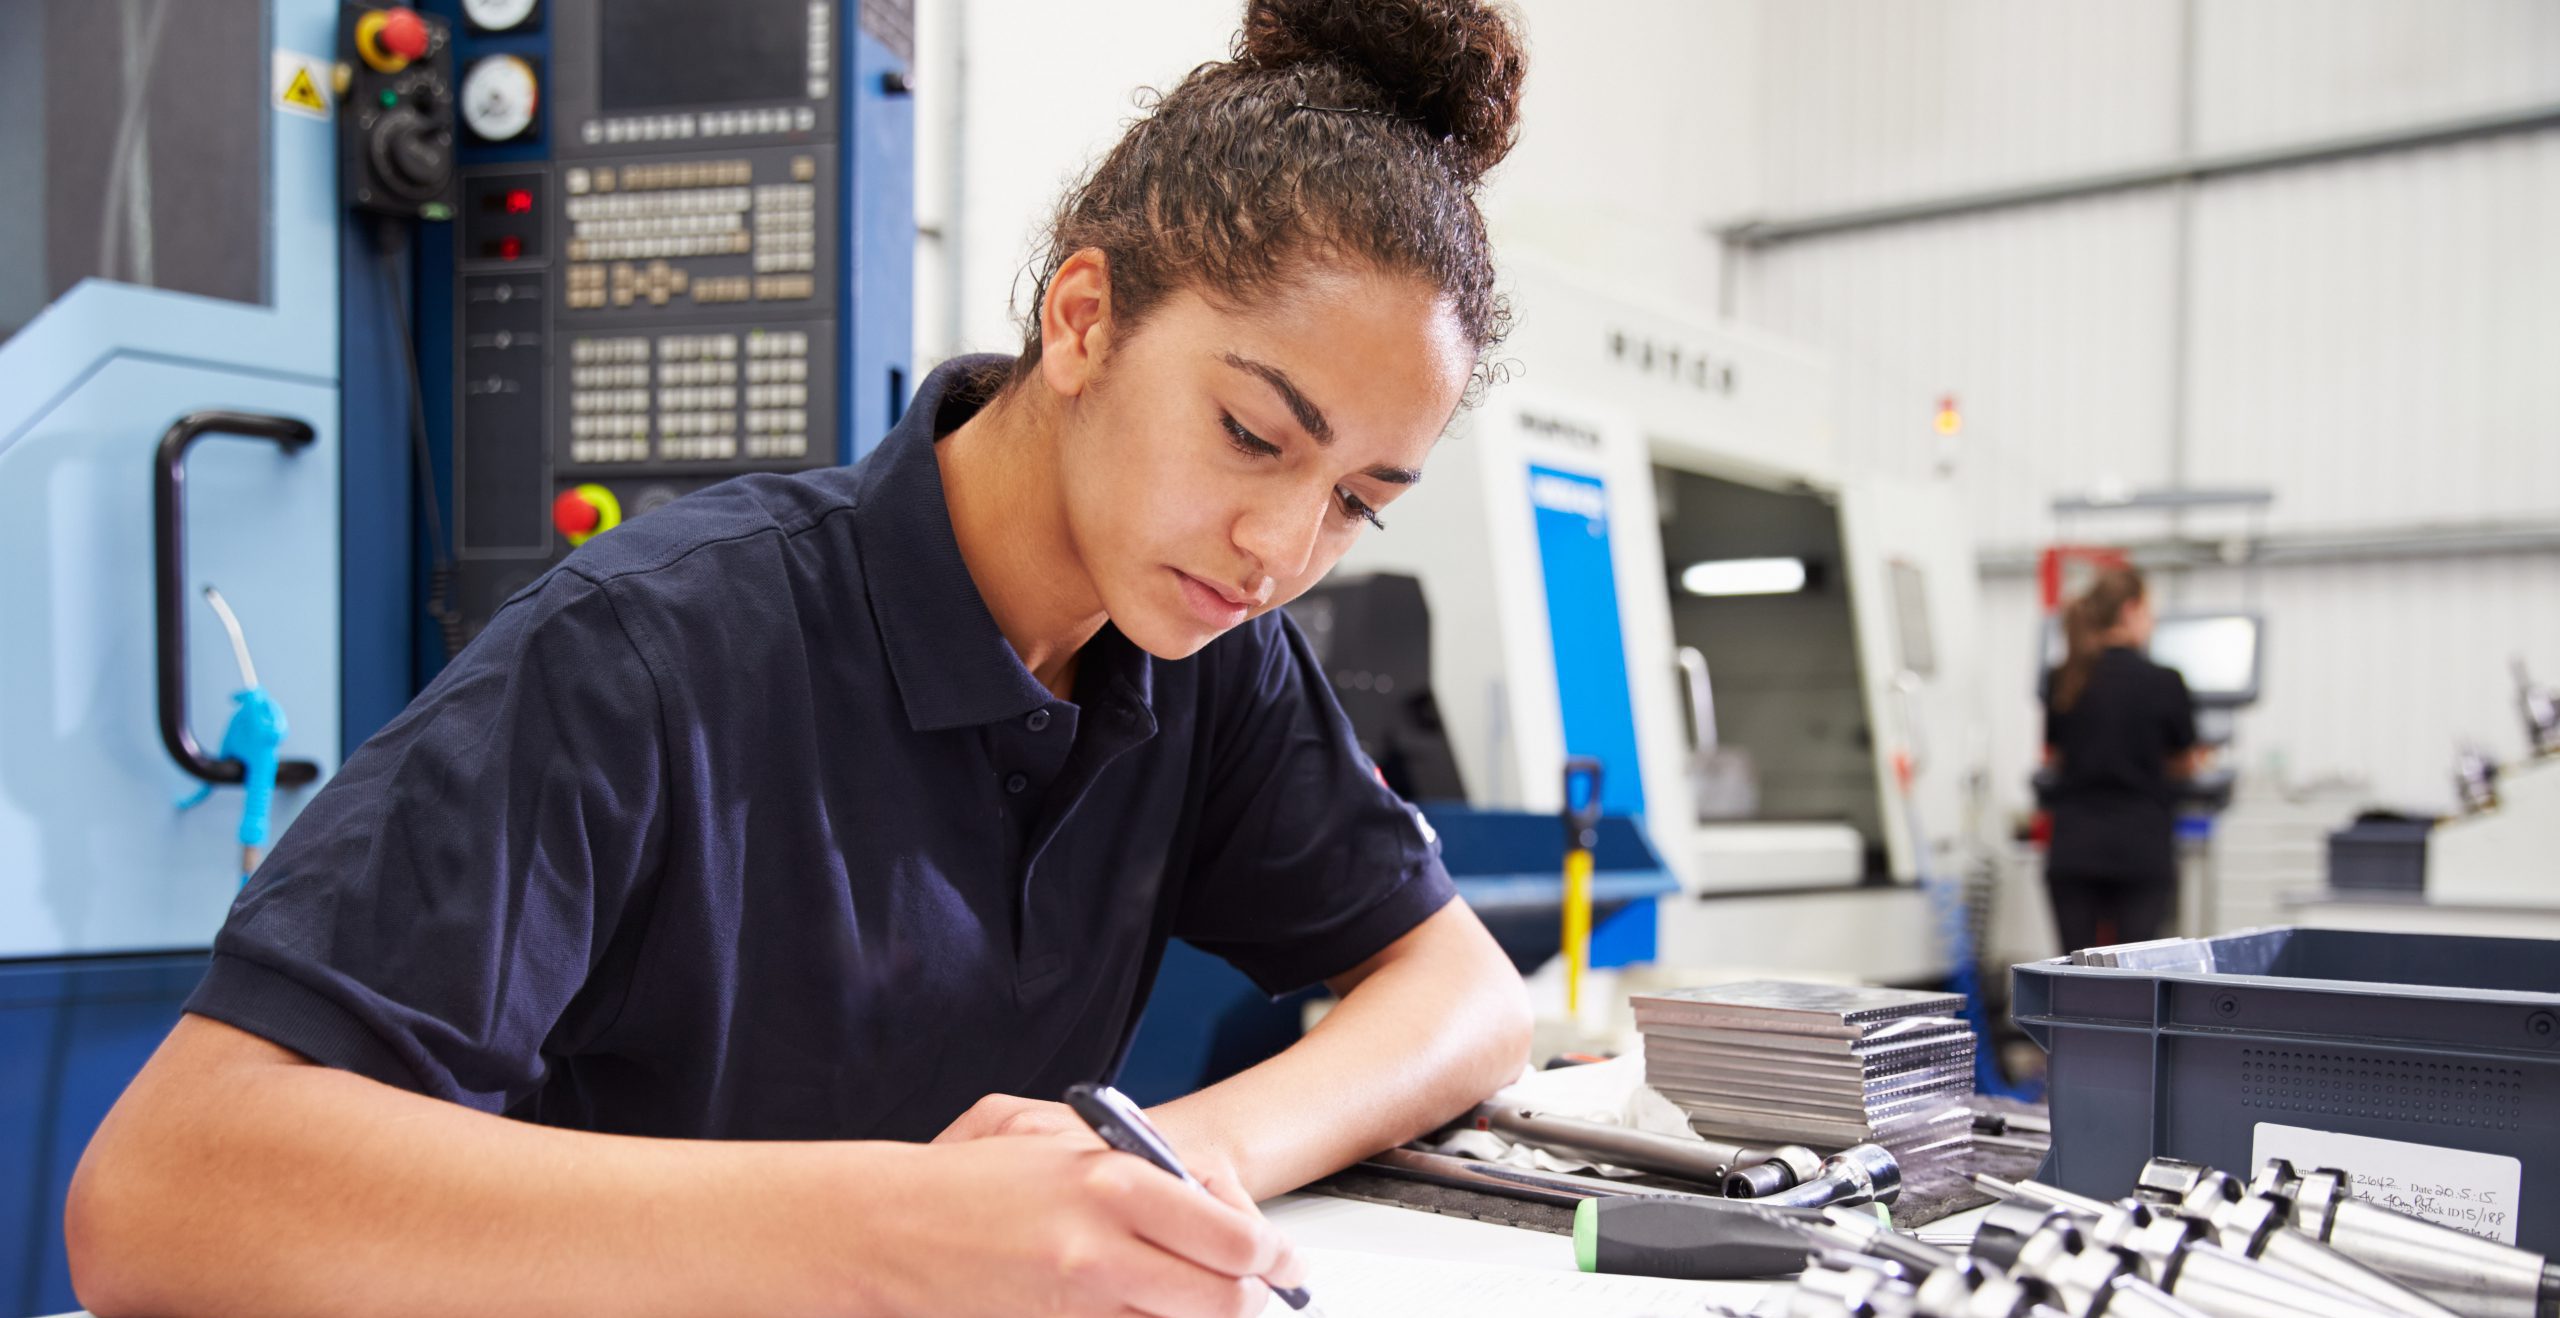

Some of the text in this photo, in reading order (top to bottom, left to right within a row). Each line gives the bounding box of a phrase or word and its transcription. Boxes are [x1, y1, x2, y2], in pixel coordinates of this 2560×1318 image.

[2410, 1183, 2433, 1195] Date
[2418, 1203, 2445, 1216] Stock
[2448, 1207, 2460, 1217] ID
